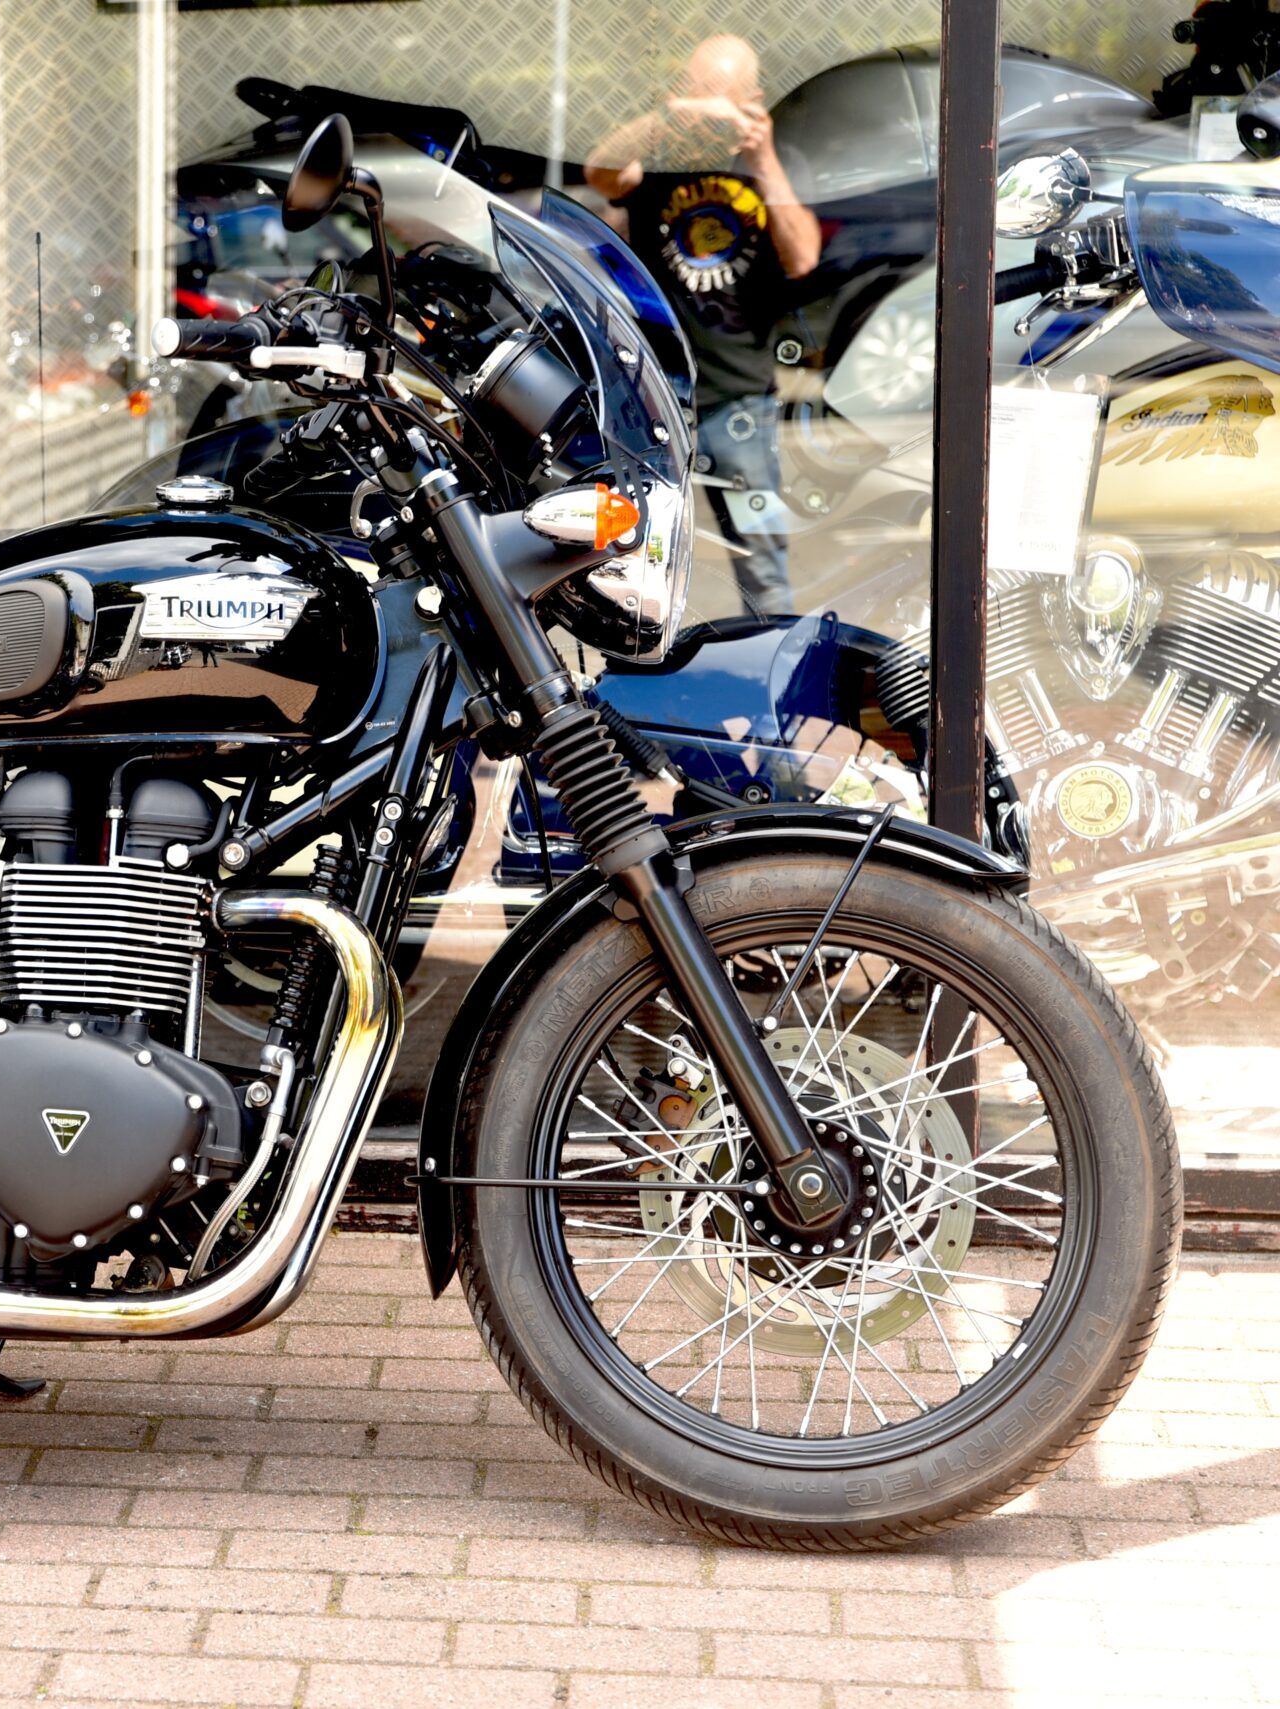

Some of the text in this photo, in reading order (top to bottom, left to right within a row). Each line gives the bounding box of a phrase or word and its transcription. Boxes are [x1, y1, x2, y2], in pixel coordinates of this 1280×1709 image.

[1122, 408, 1208, 432] Indian
[160, 596, 284, 629] TRIUMPH
[49, 1116, 81, 1128] TRIUMPH
[844, 1311, 1115, 1506] LASERTEC
